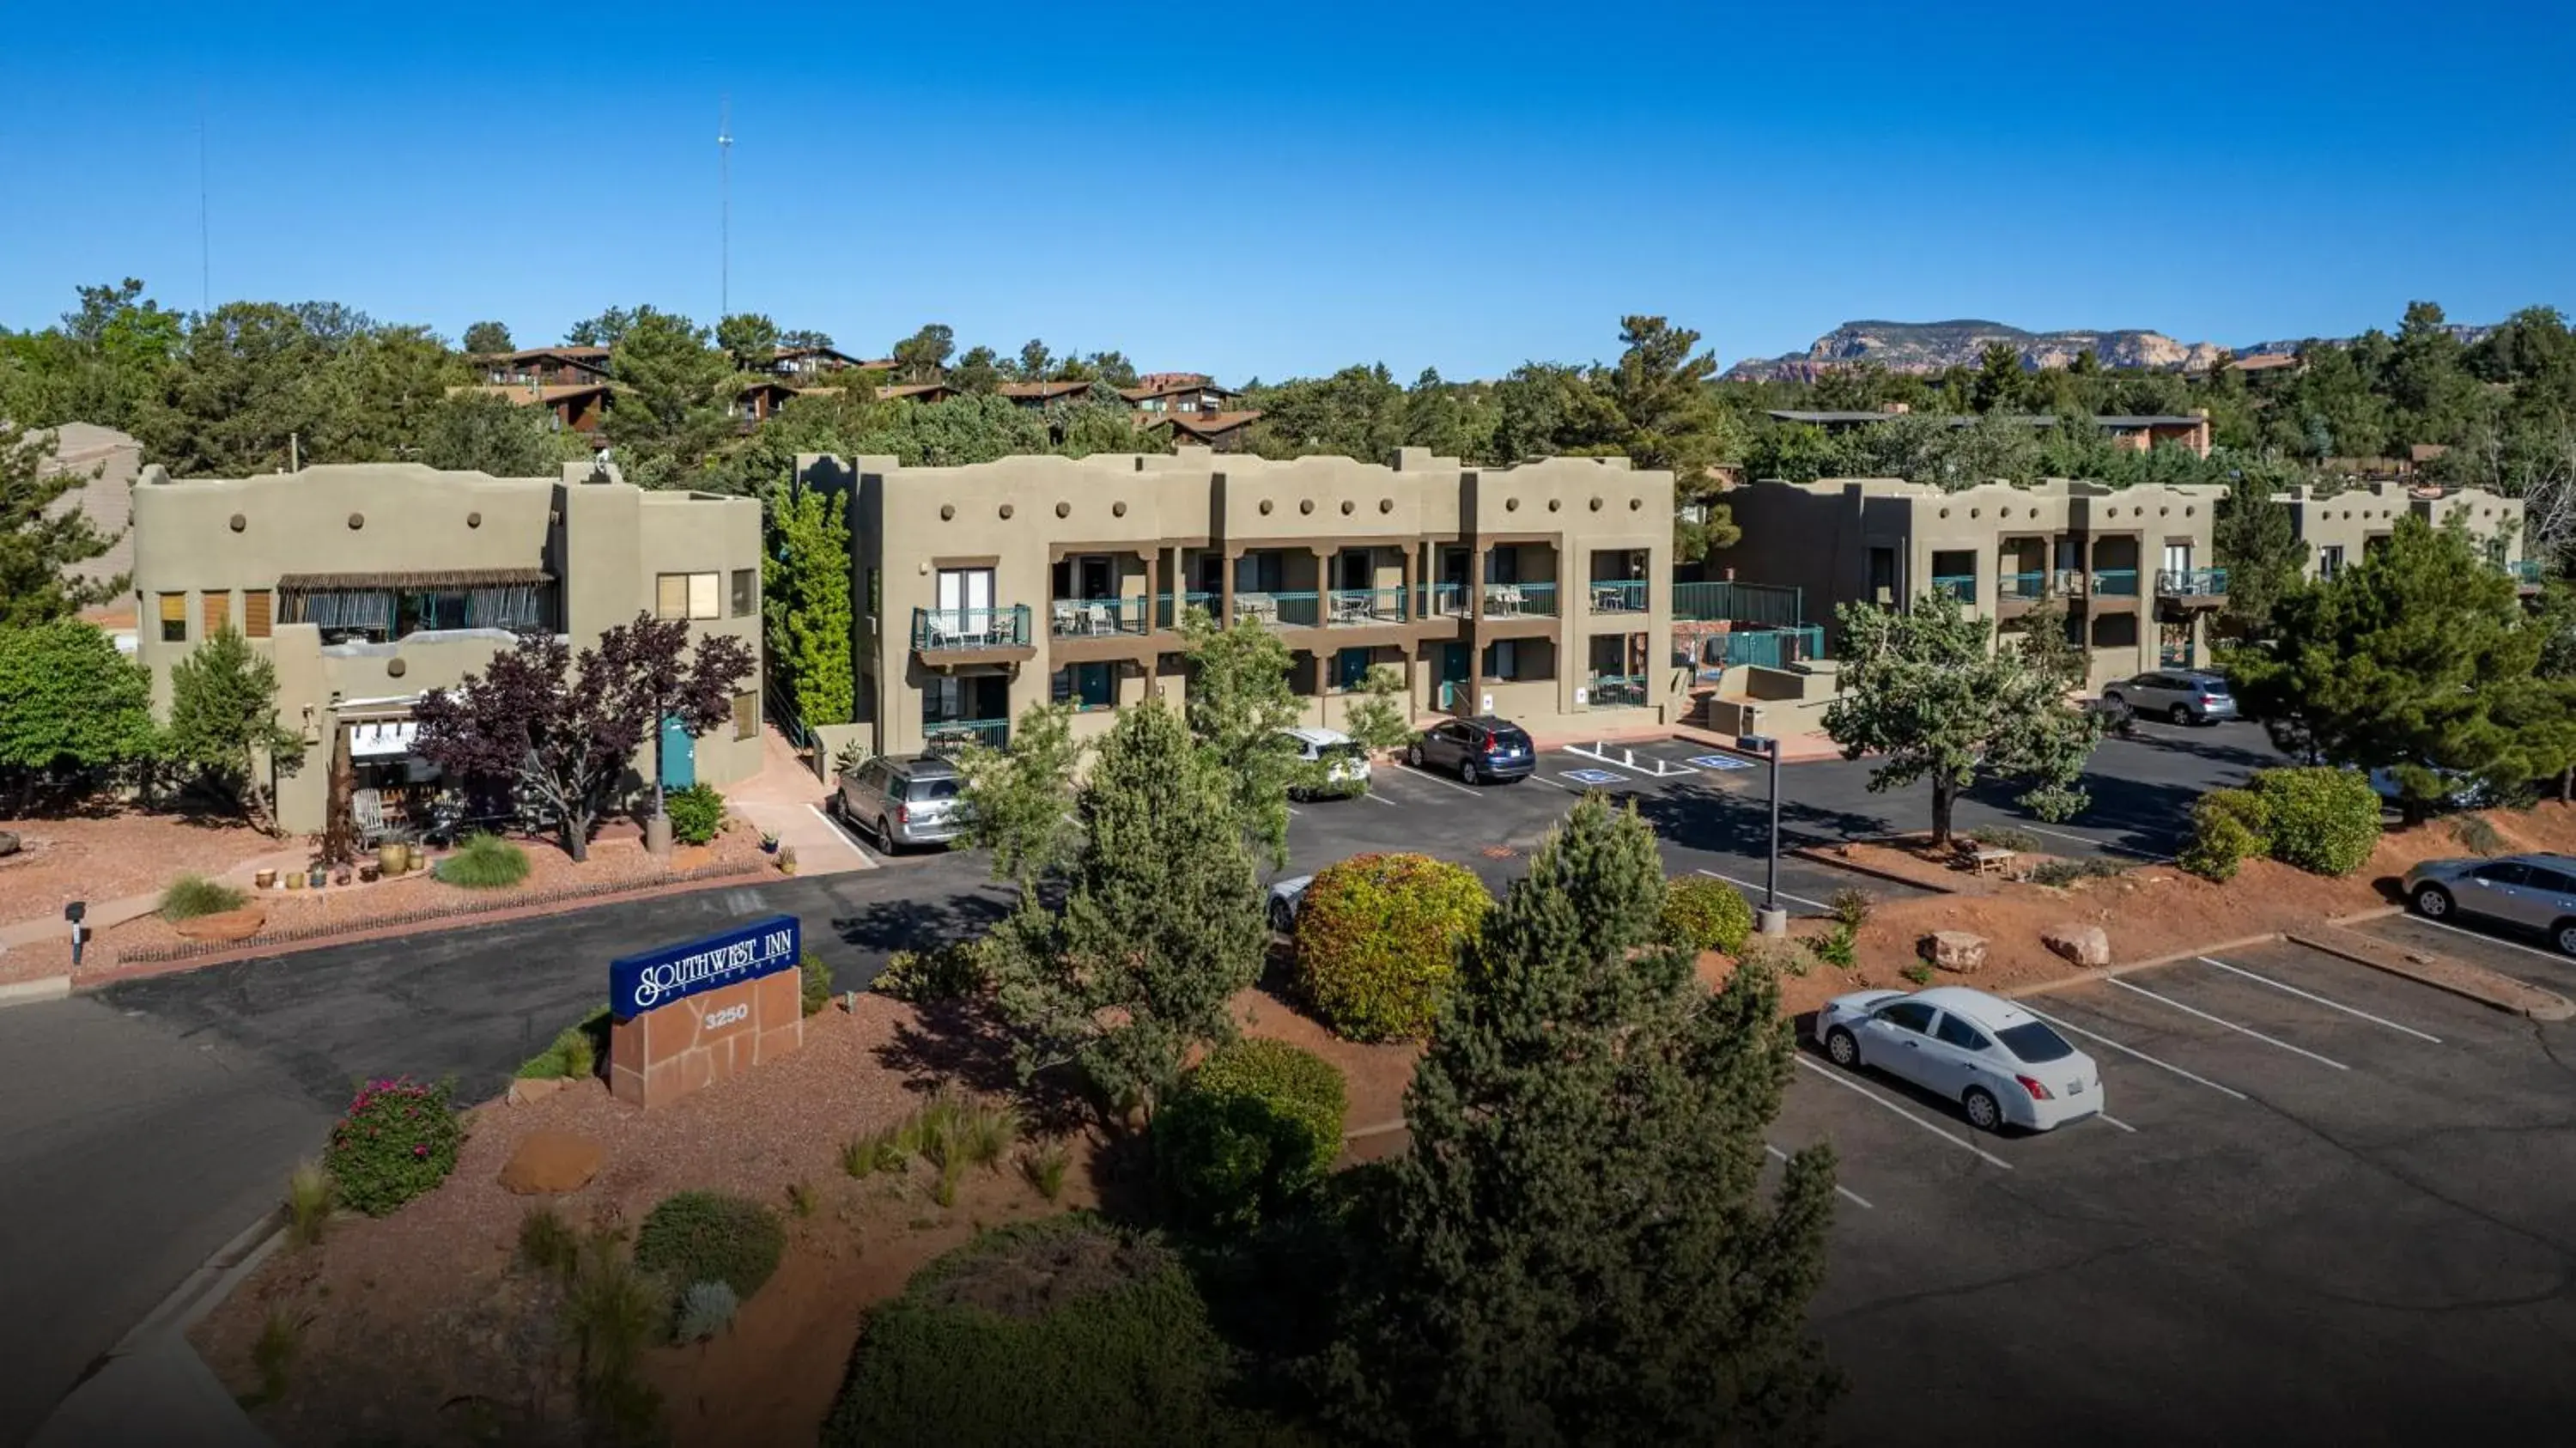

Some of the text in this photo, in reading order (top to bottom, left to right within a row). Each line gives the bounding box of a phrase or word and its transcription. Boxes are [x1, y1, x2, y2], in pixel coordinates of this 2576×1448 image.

[635, 938, 756, 1006] SOUTHWEST
[764, 929, 792, 958] INN
[706, 1003, 748, 1030] 3250
